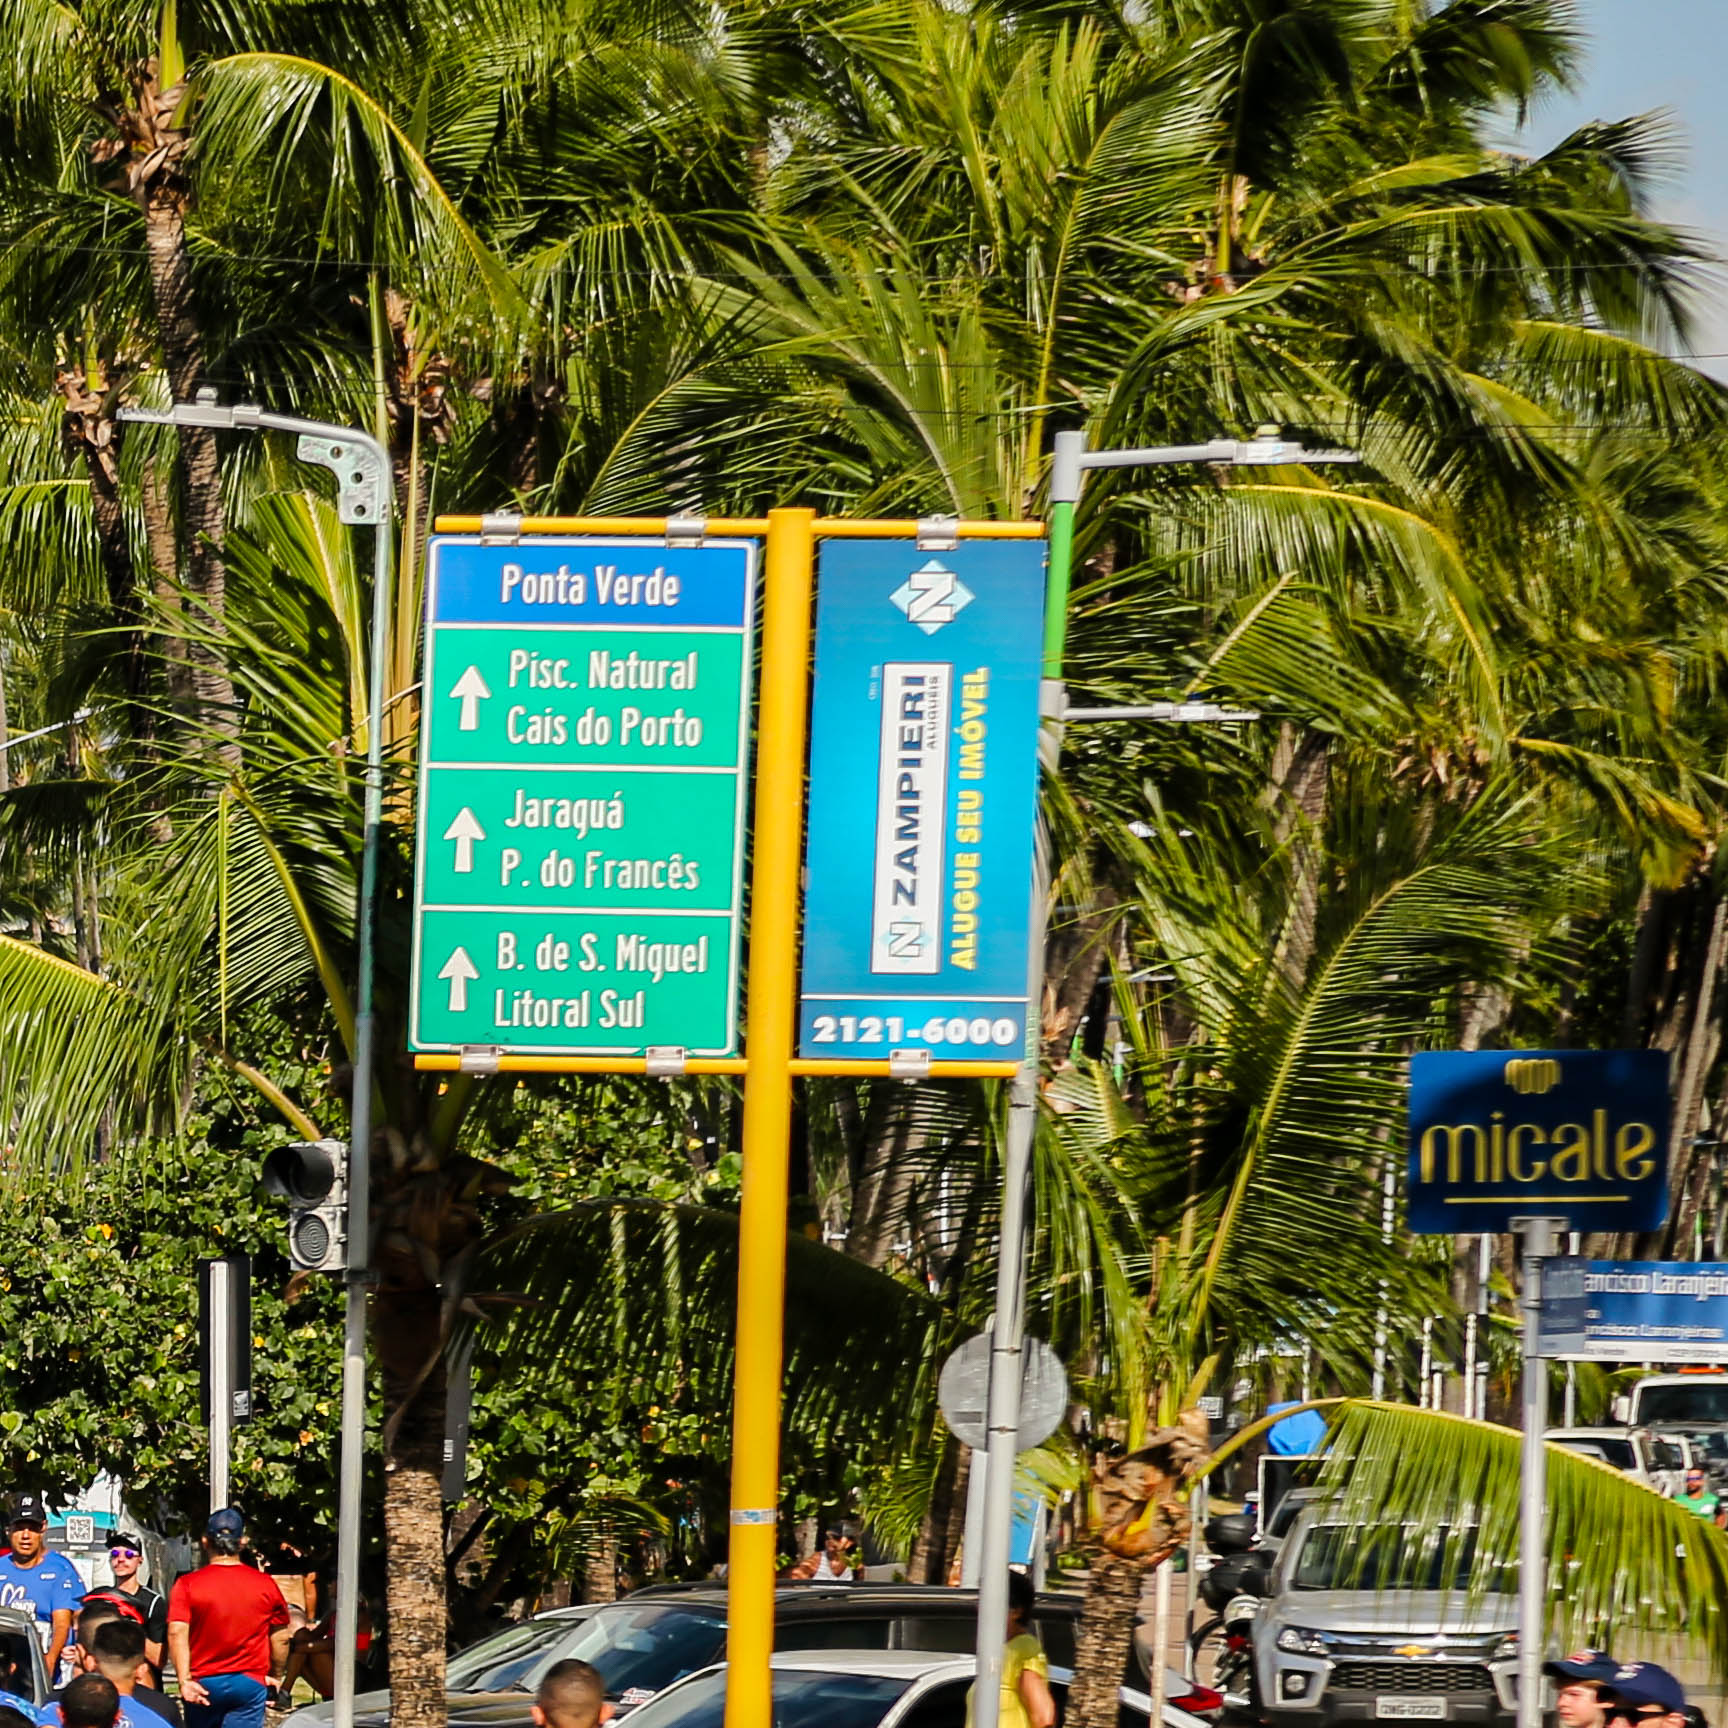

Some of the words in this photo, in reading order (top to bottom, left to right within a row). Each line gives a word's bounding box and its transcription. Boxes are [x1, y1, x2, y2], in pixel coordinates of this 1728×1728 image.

[501, 565, 583, 605] Ponta
[596, 566, 681, 606] Verde
[508, 651, 579, 691] Pisc.
[589, 651, 699, 691] Natural
[507, 707, 568, 746] Cais
[577, 709, 612, 746] do
[620, 710, 703, 748] Porto
[953, 667, 990, 780] IMÓVEL
[505, 789, 624, 840] Jaraguá
[892, 674, 927, 906] ZAMPIERI
[956, 789, 985, 845] SEU
[501, 849, 531, 889] P.
[540, 851, 576, 889] do
[584, 852, 700, 891] Francês
[950, 852, 982, 971] ALUGUE
[497, 933, 528, 970] B.
[535, 934, 570, 971] de
[579, 934, 607, 972] S.
[616, 935, 709, 982] Miguel
[495, 989, 590, 1028] Litoral
[598, 991, 644, 1029] Sul
[812, 1015, 1016, 1045] 2121-6000
[1420, 1110, 1657, 1183] micale
